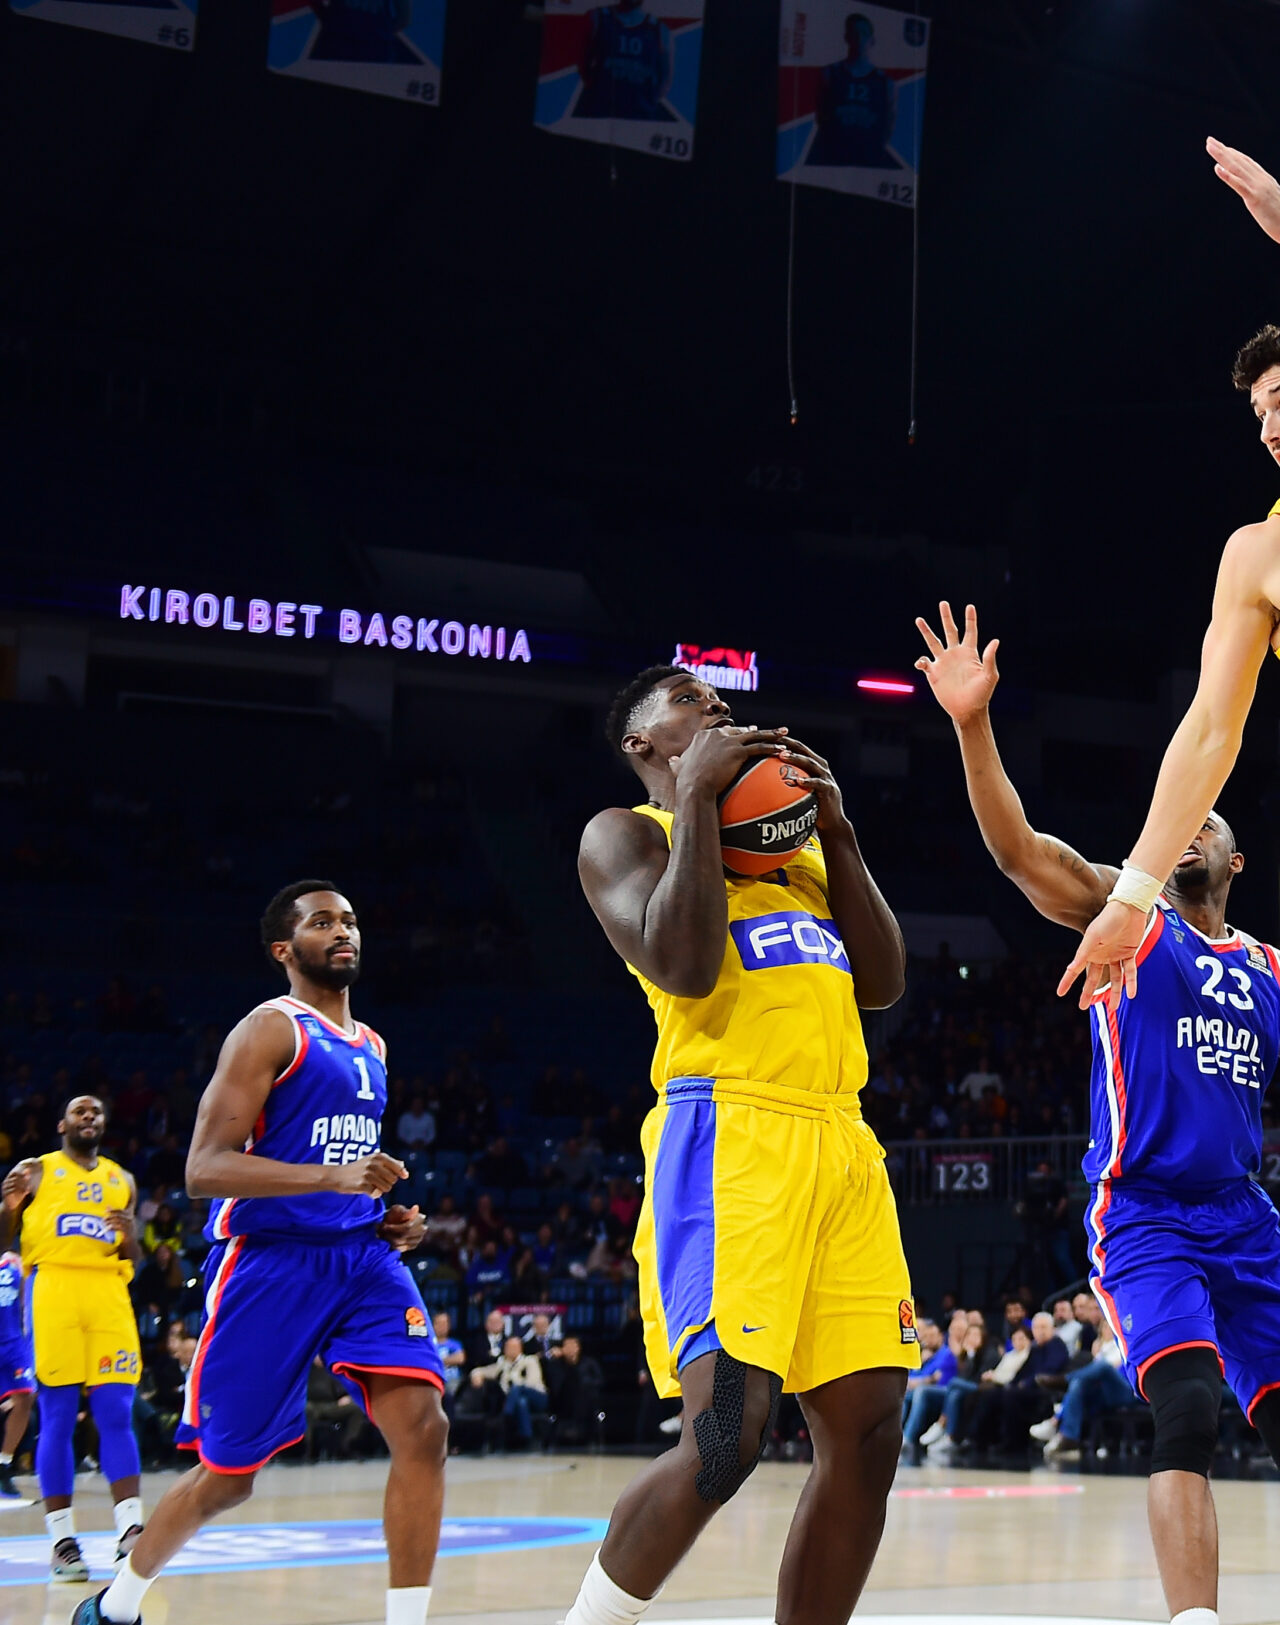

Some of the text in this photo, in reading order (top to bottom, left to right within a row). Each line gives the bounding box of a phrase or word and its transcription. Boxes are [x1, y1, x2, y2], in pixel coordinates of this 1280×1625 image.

[158, 25, 189, 47] #6
[407, 80, 435, 102] #8
[650, 133, 689, 157] #10
[879, 181, 913, 204] #12
[120, 583, 532, 664] KIROLBET BASKONIA
[749, 920, 850, 966] FOX
[1195, 955, 1254, 1011] 23
[353, 1056, 376, 1101] 1
[935, 1162, 990, 1191] 123
[77, 1182, 103, 1203] 28
